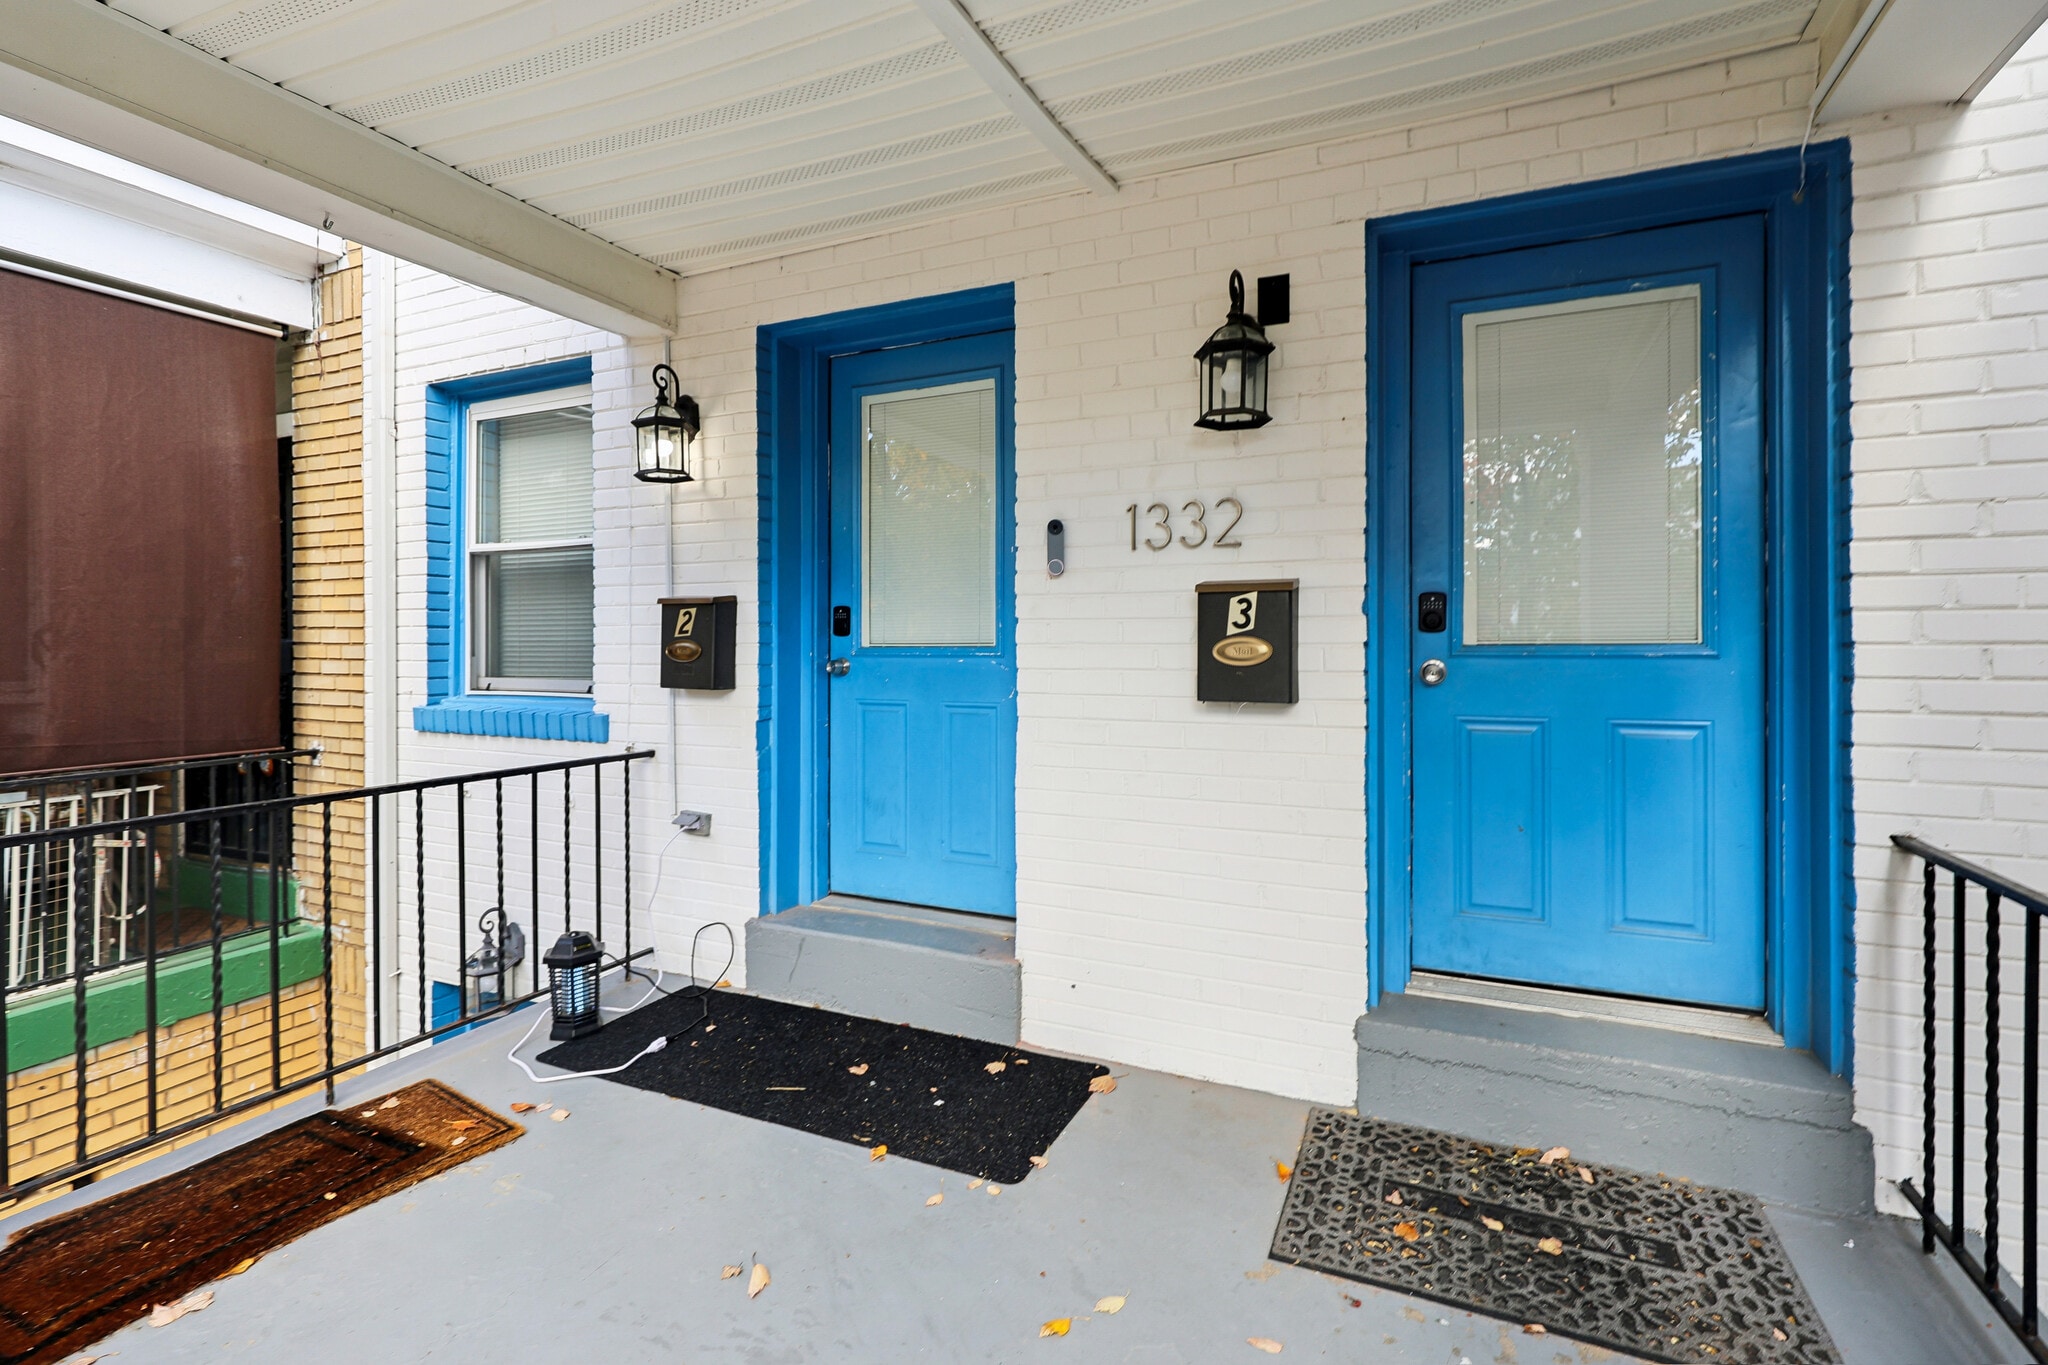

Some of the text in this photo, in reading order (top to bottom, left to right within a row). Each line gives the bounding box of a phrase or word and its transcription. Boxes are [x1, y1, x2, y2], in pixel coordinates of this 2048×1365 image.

[1126, 497, 1243, 551] 1332
[677, 610, 693, 635] 2
[1231, 597, 1253, 629] 3
